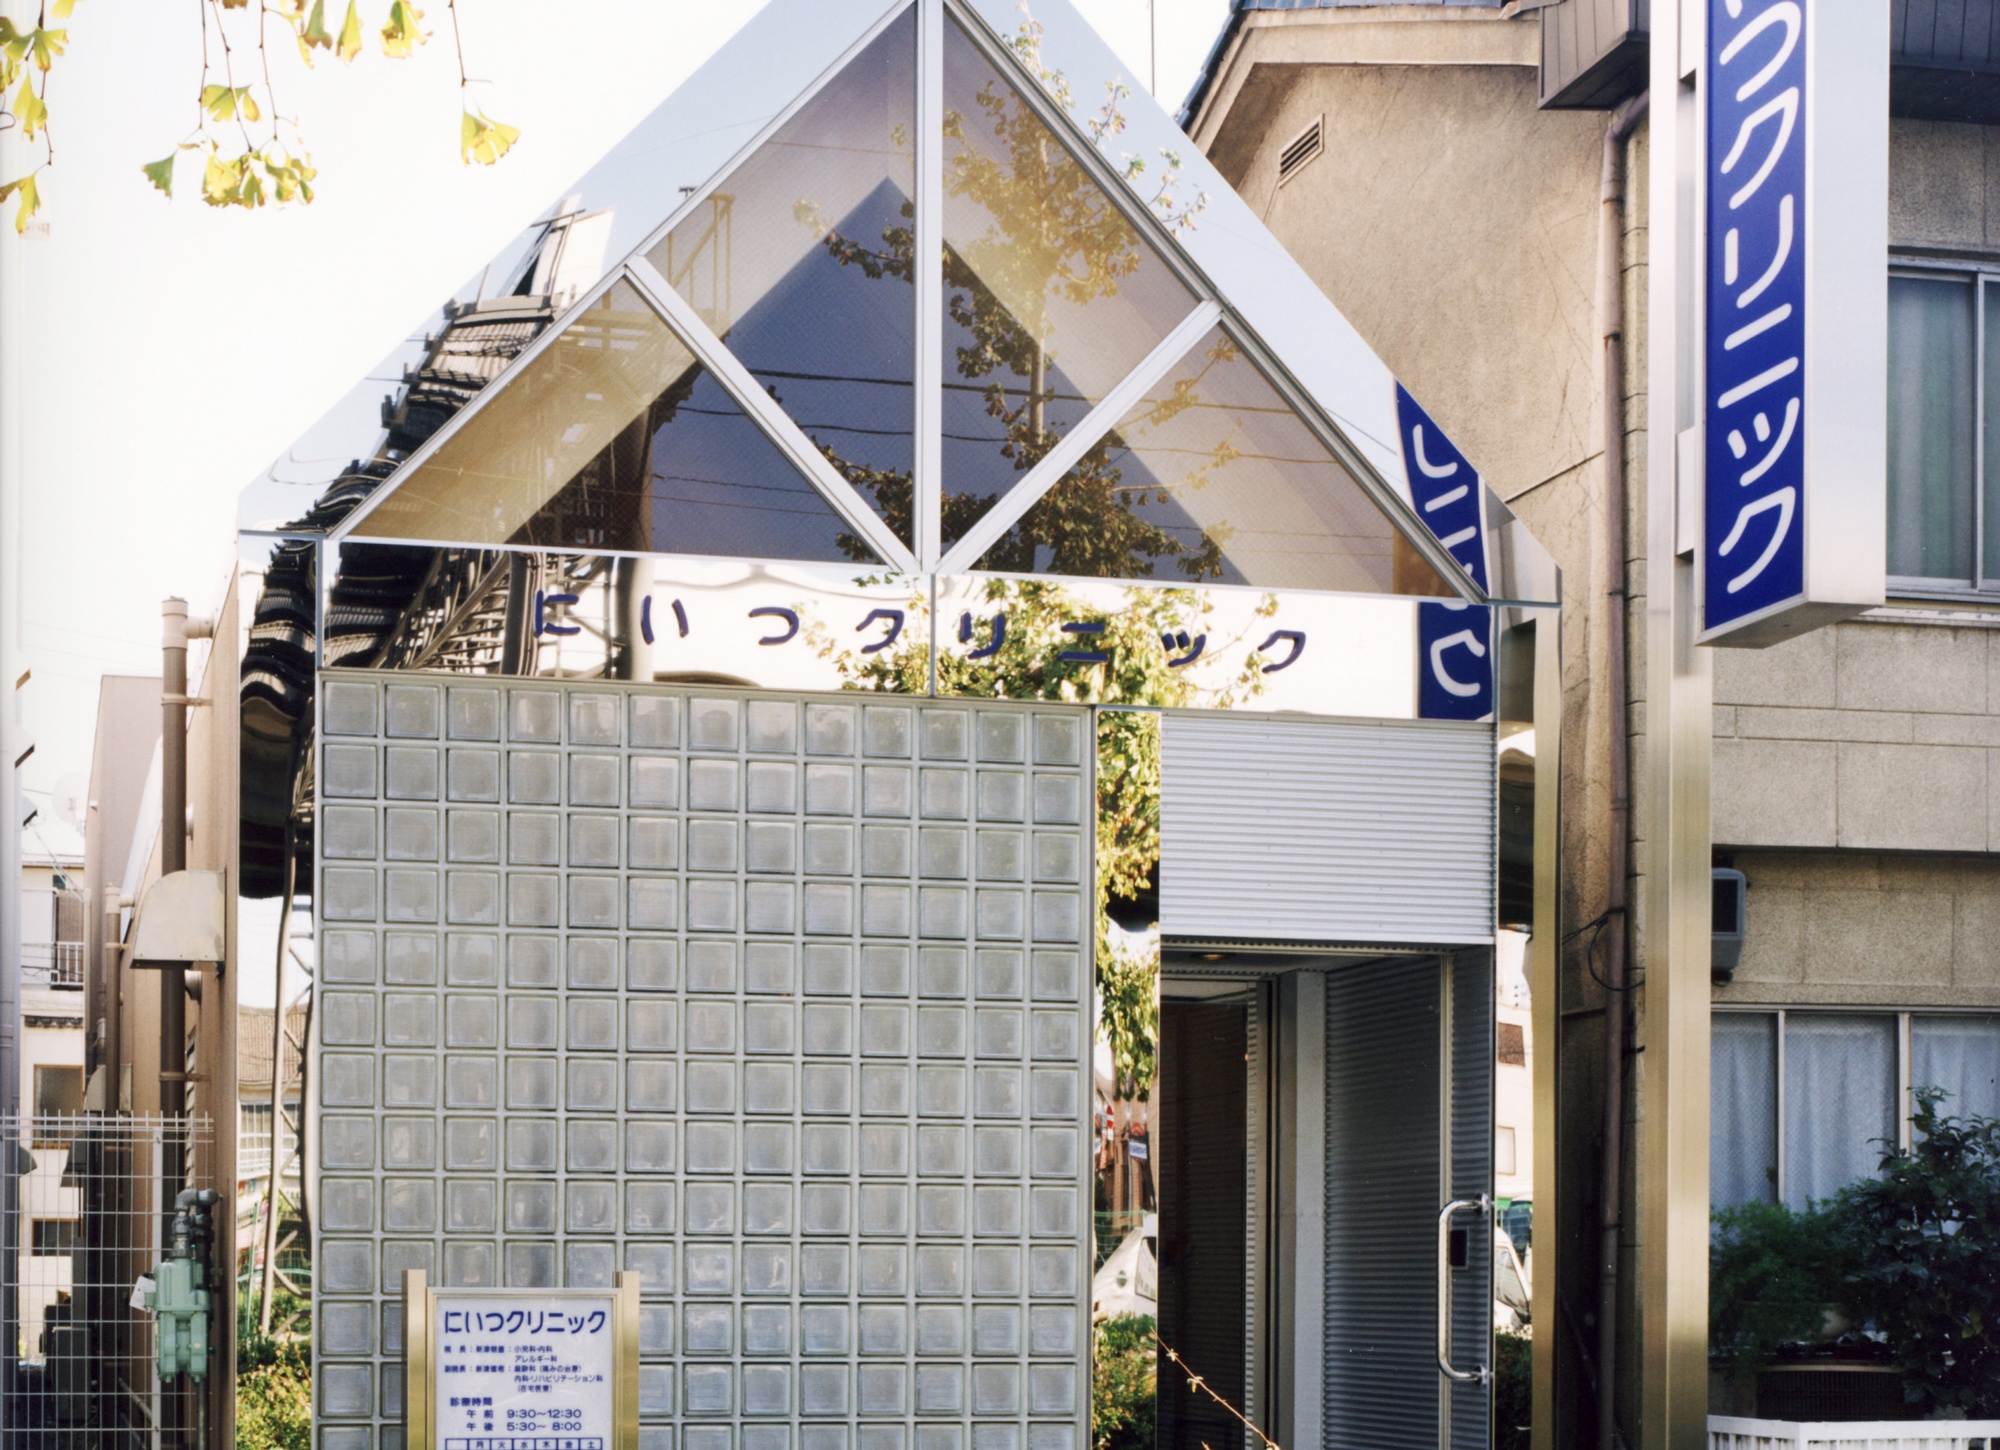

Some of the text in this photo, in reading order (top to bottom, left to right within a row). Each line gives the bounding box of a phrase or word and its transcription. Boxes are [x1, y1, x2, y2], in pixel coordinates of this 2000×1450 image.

[1718, 0, 1802, 594] つクリニック
[534, 589, 1306, 675] にいつクリニック
[445, 1311, 606, 1334] にいつクリニック
[450, 1397, 492, 1407] 診療時間
